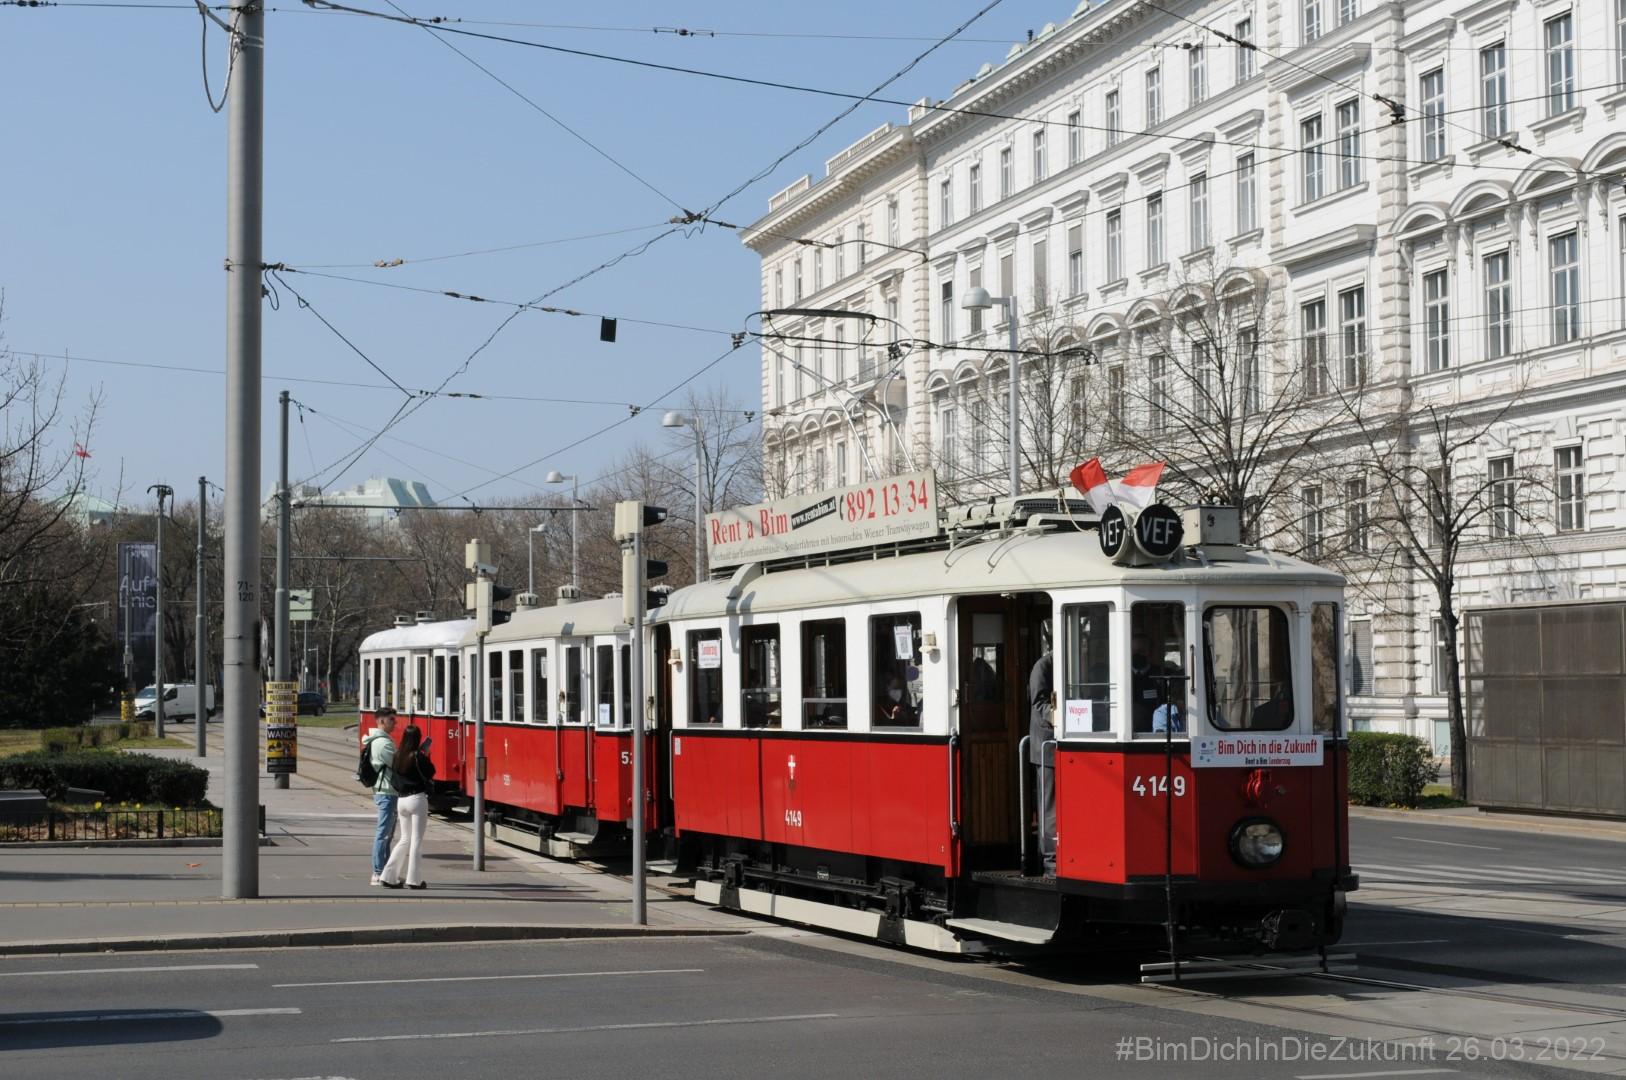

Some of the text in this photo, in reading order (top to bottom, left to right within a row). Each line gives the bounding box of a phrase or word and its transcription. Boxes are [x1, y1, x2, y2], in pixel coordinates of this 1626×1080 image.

[847, 478, 928, 523] 892 13 34
[711, 508, 788, 545] Rent a Bim
[864, 527, 884, 539] Wiener
[1101, 518, 1122, 548] VEF
[1141, 516, 1177, 545] VEF
[119, 593, 156, 608] Lnie
[239, 591, 254, 602] 120
[1068, 705, 1089, 716] Wagen
[267, 730, 296, 739] WANDA
[1218, 739, 1318, 755] Bim Dich in die Zukunft
[1132, 775, 1186, 797] 4149
[785, 809, 802, 827] 4149
